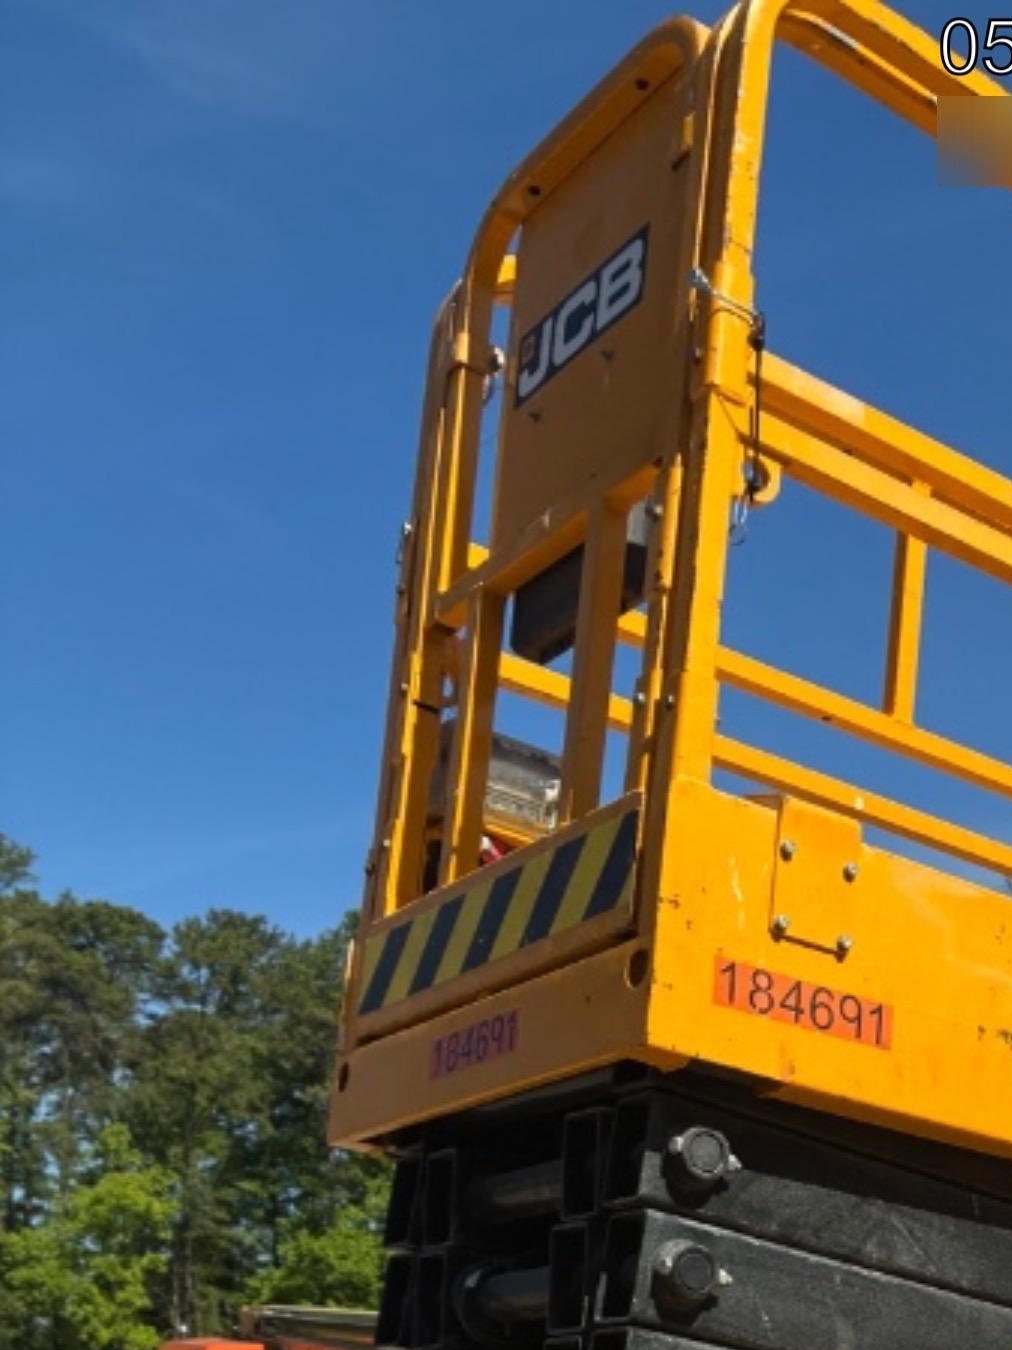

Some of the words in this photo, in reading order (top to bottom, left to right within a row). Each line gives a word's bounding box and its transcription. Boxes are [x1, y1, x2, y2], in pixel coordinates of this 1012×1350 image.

[518, 238, 644, 398] JCB
[433, 1009, 518, 1076] 184691
[720, 960, 884, 1046] 184691
